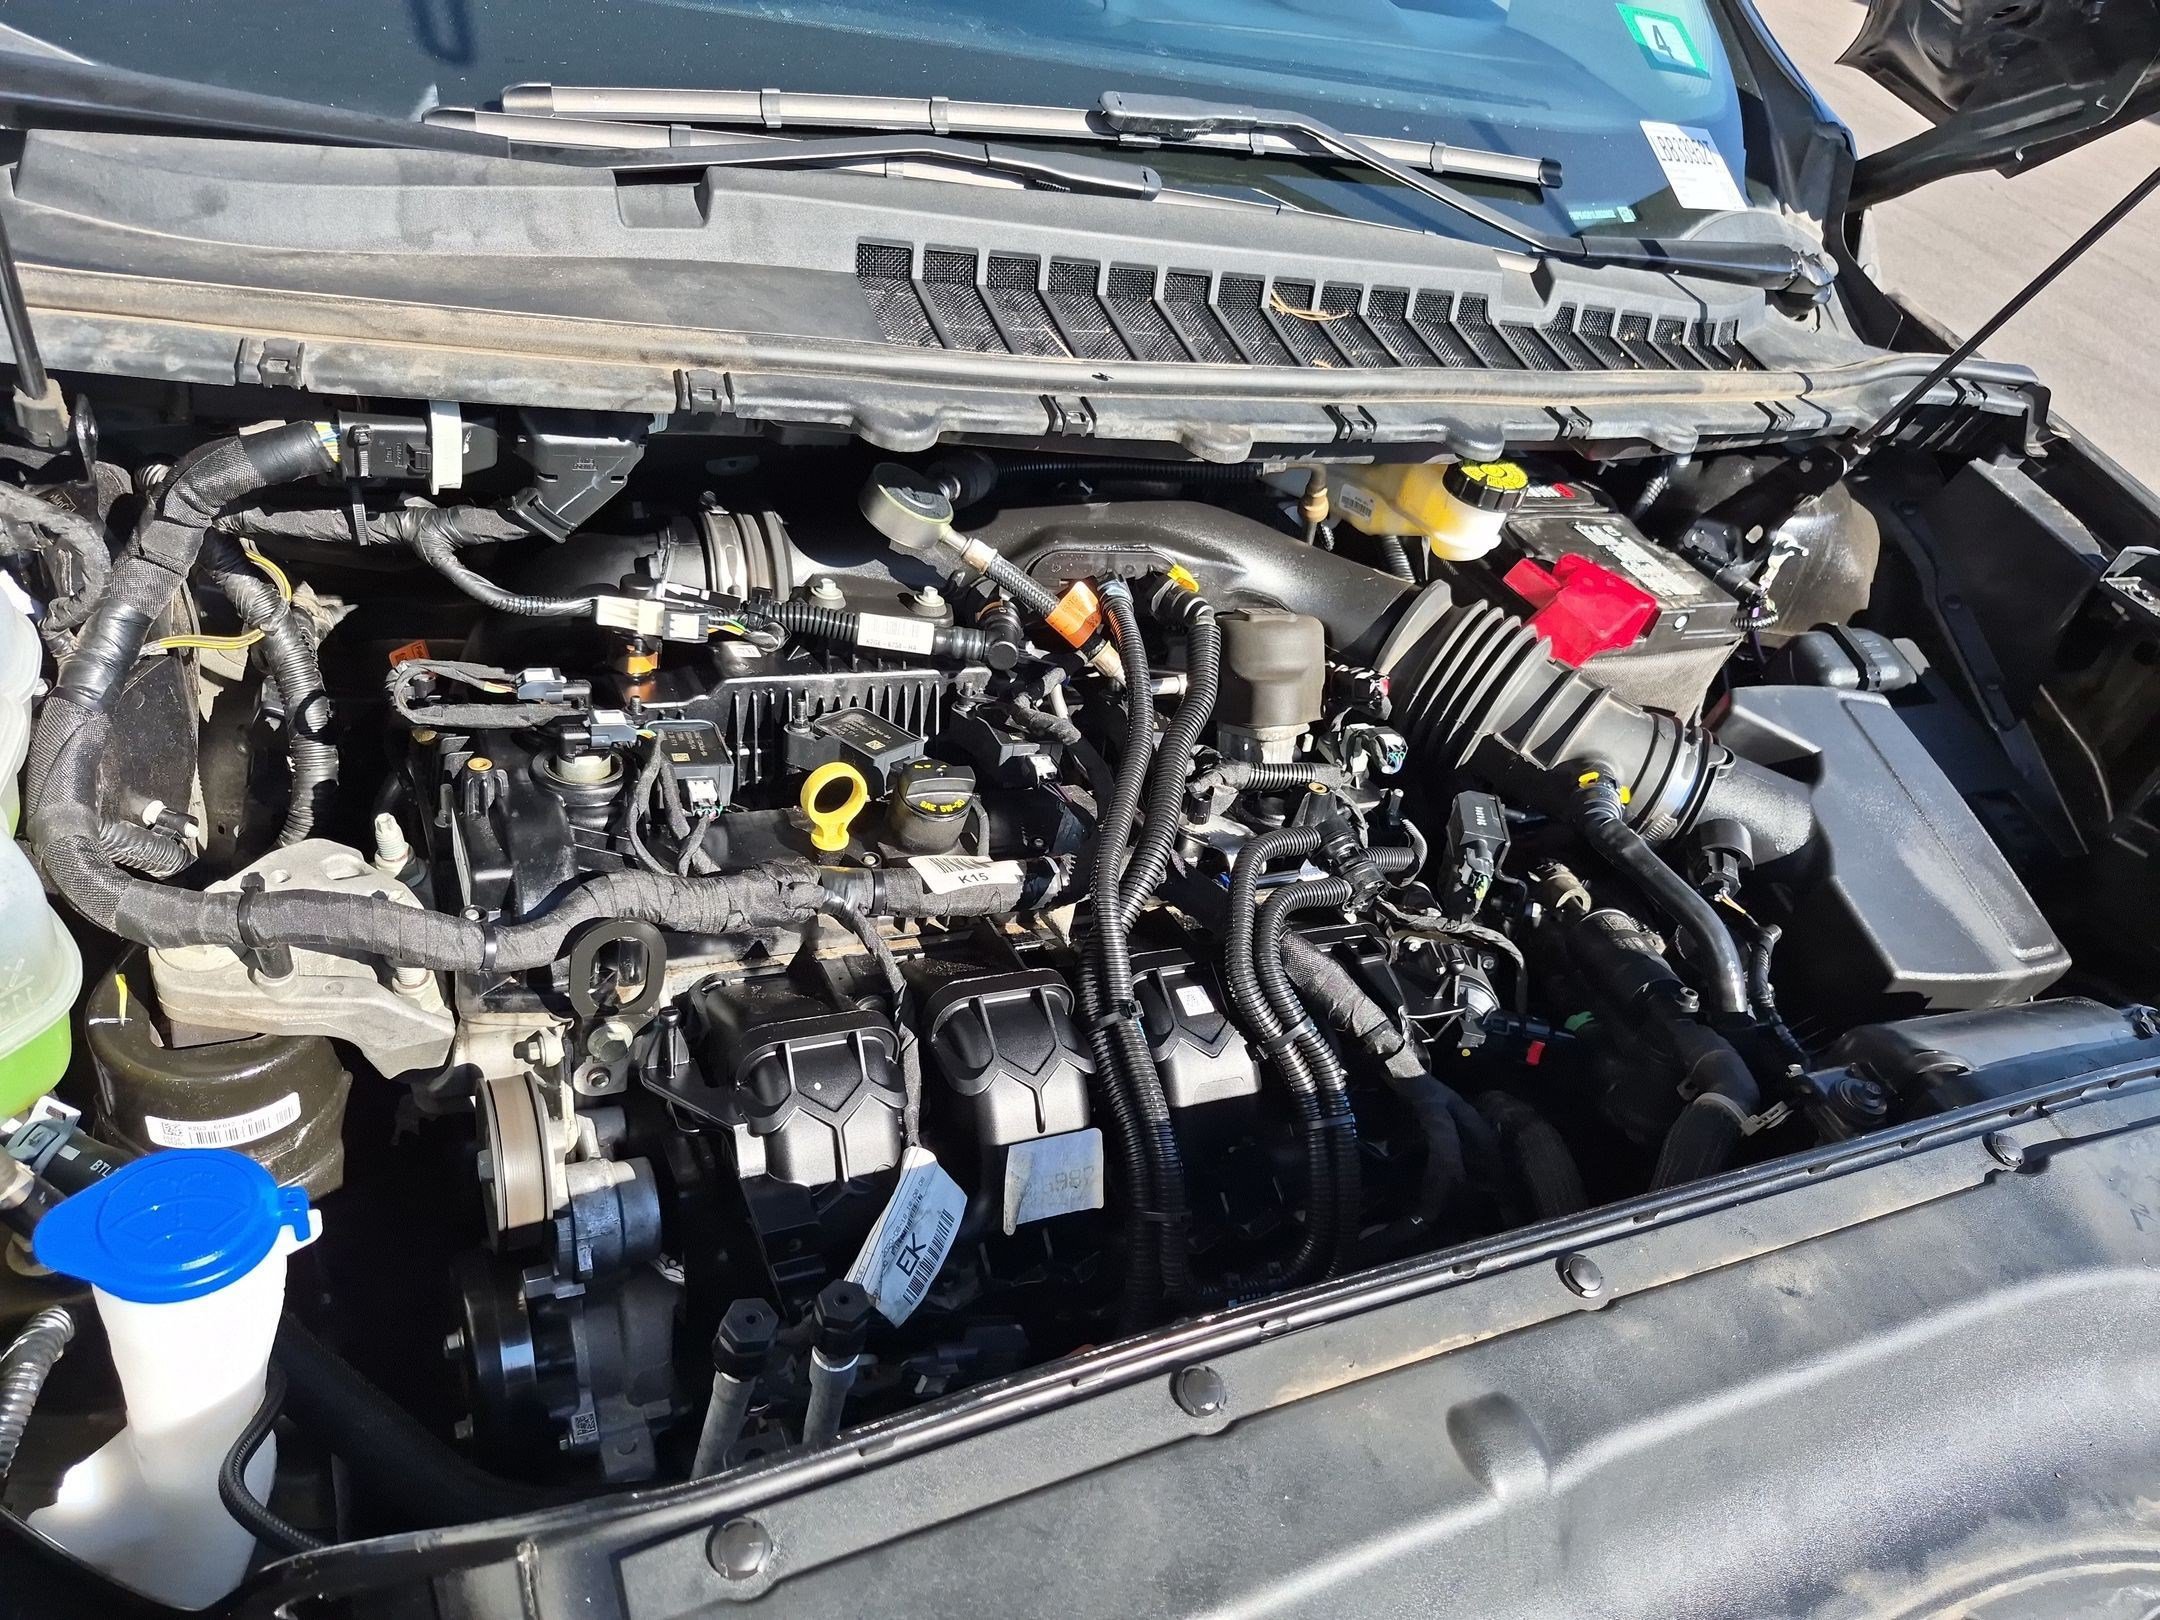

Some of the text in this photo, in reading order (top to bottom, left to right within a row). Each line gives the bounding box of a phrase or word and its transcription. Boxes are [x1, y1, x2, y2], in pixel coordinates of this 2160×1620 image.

[1652, 24, 1675, 59] 4
[920, 800, 937, 812] SAE
[958, 871, 990, 885] K15
[895, 1232, 927, 1278] EK
